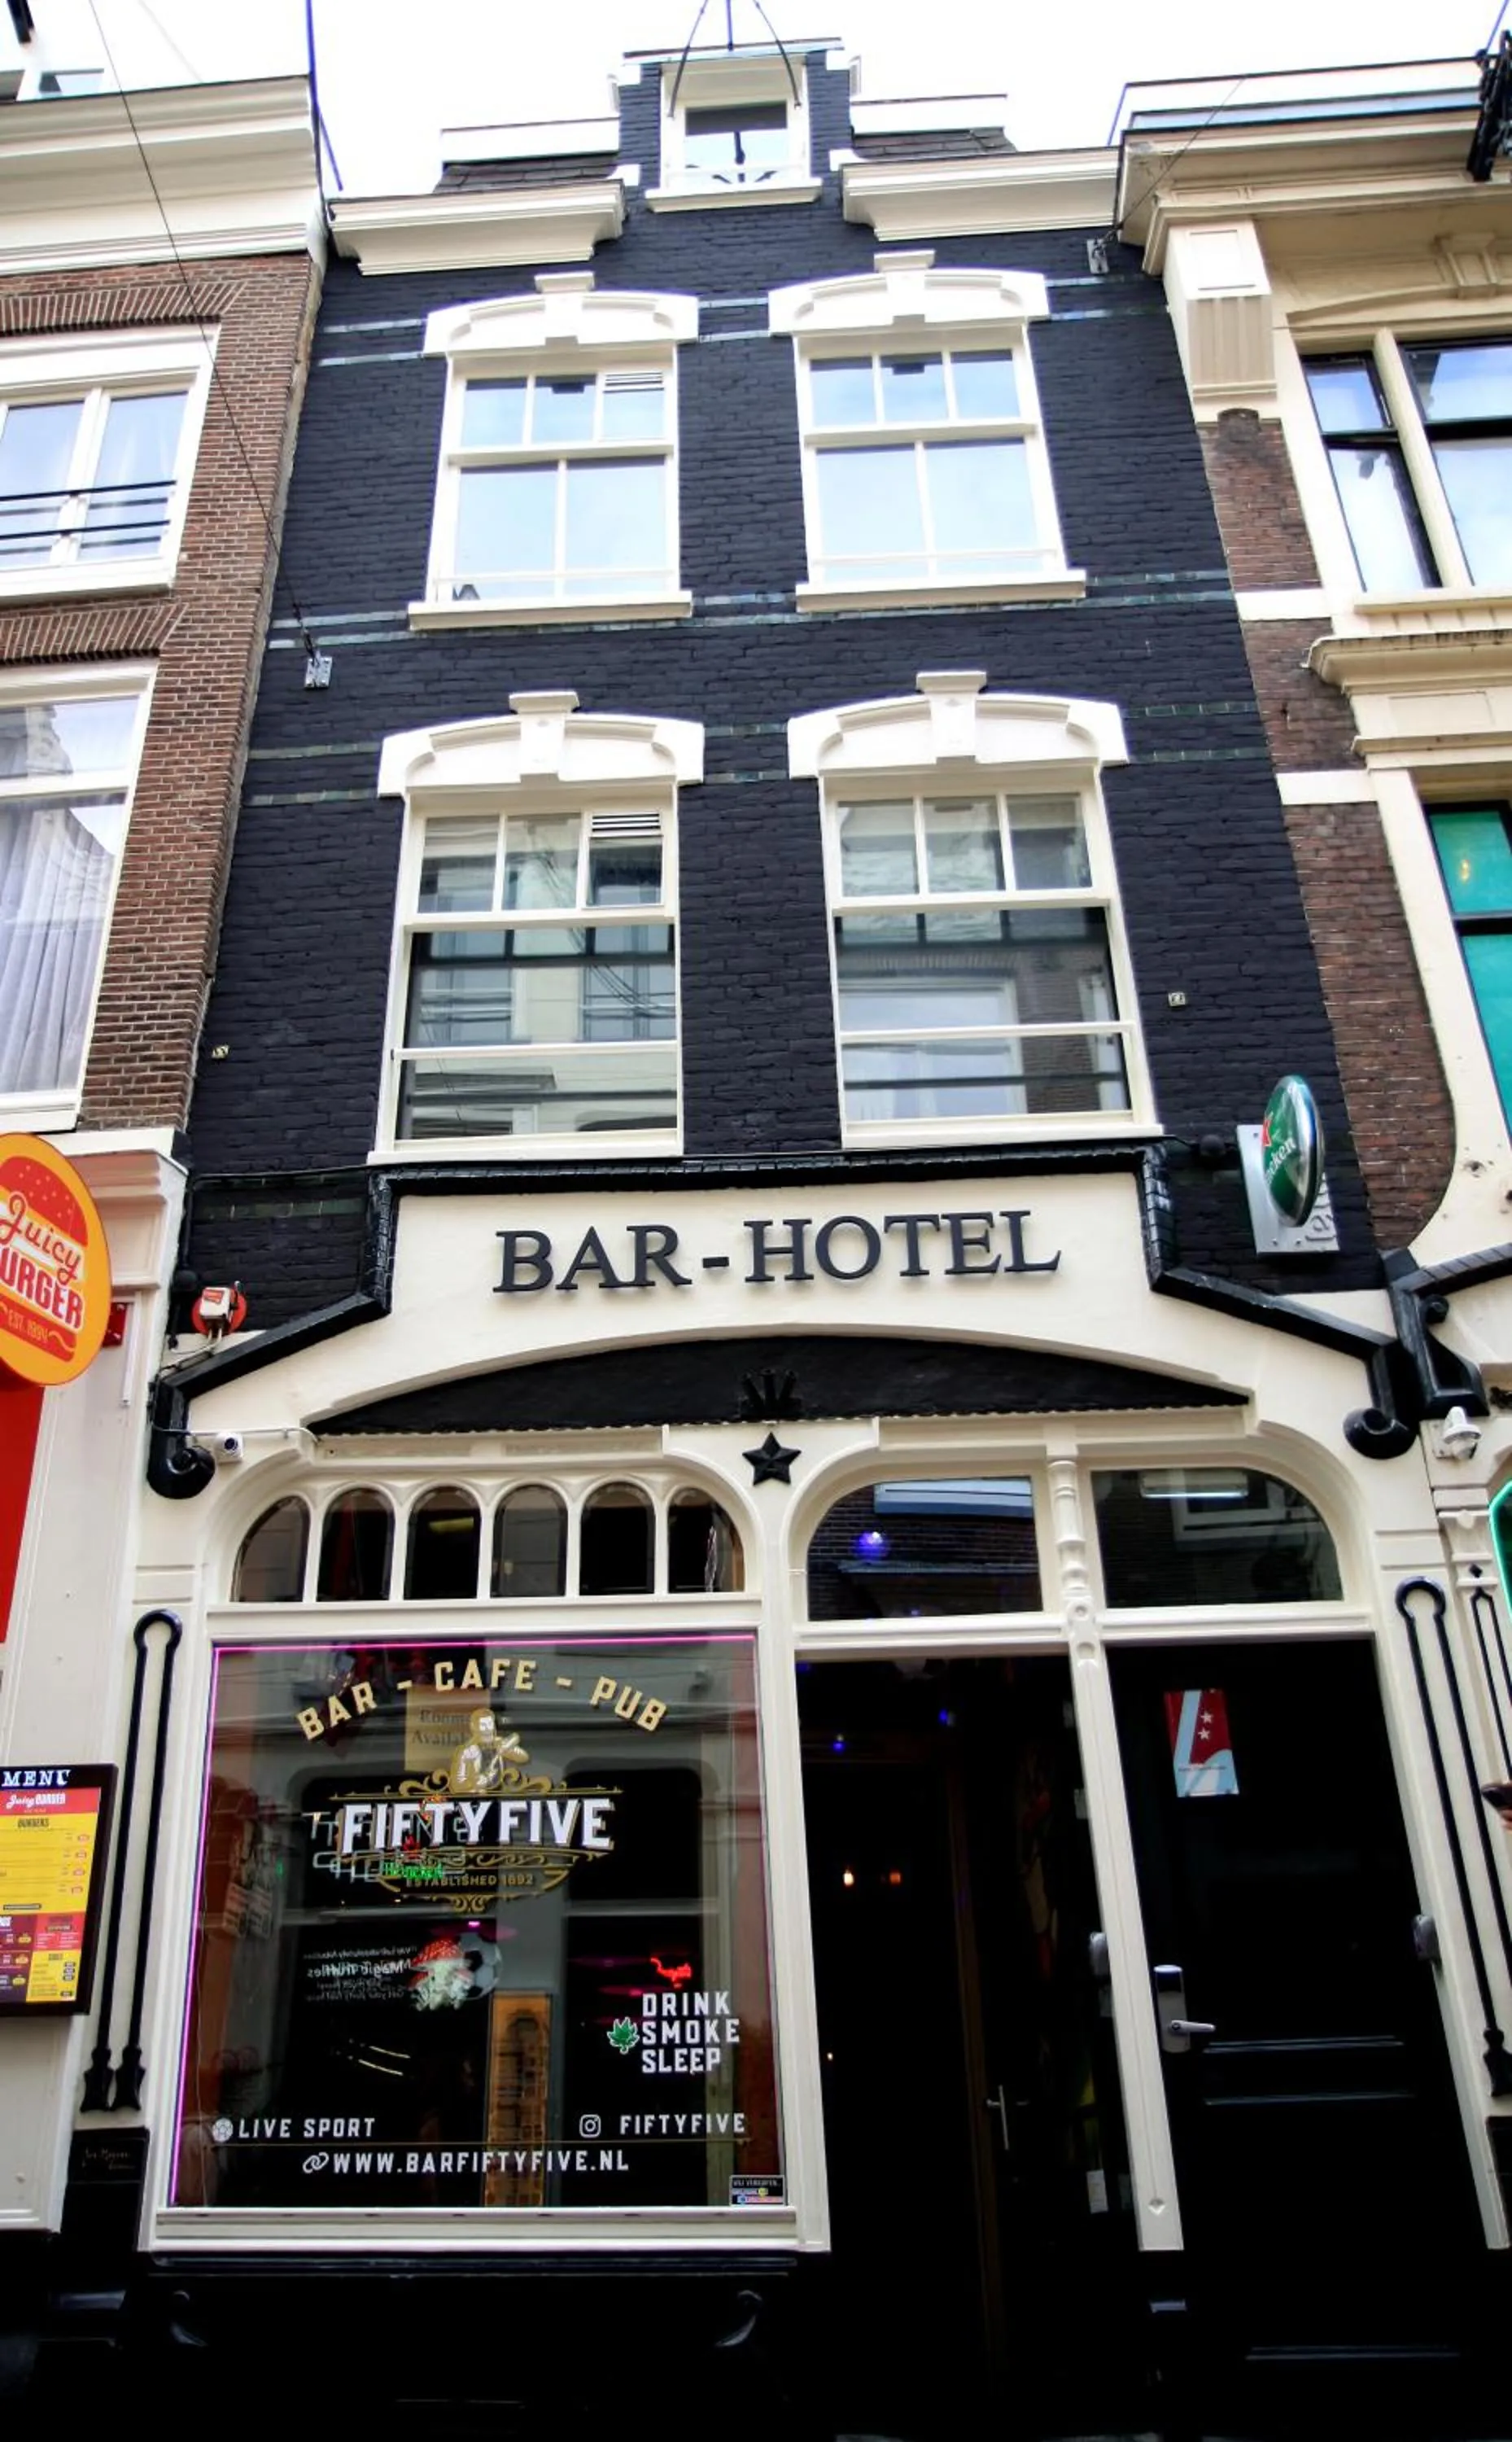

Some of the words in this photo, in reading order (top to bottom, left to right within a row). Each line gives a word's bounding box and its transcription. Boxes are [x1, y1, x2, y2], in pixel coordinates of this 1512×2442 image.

[0, 1247, 82, 1330] URGER
[295, 1681, 378, 1741] BAR
[434, 1658, 536, 1691] CAFE
[590, 1676, 668, 1731] PUB
[406, 1874, 496, 1887] ESTABLISHED
[642, 1991, 730, 2016] DRINK
[642, 2018, 740, 2046] SMOKE
[641, 2047, 721, 2074] SLEEP
[238, 2118, 292, 2138] LIVE
[304, 2118, 375, 2138] SPORT
[620, 2112, 745, 2135] FIFTYFIVE
[334, 2150, 629, 2173] WWW.BARFIFTYFIVE.NL
